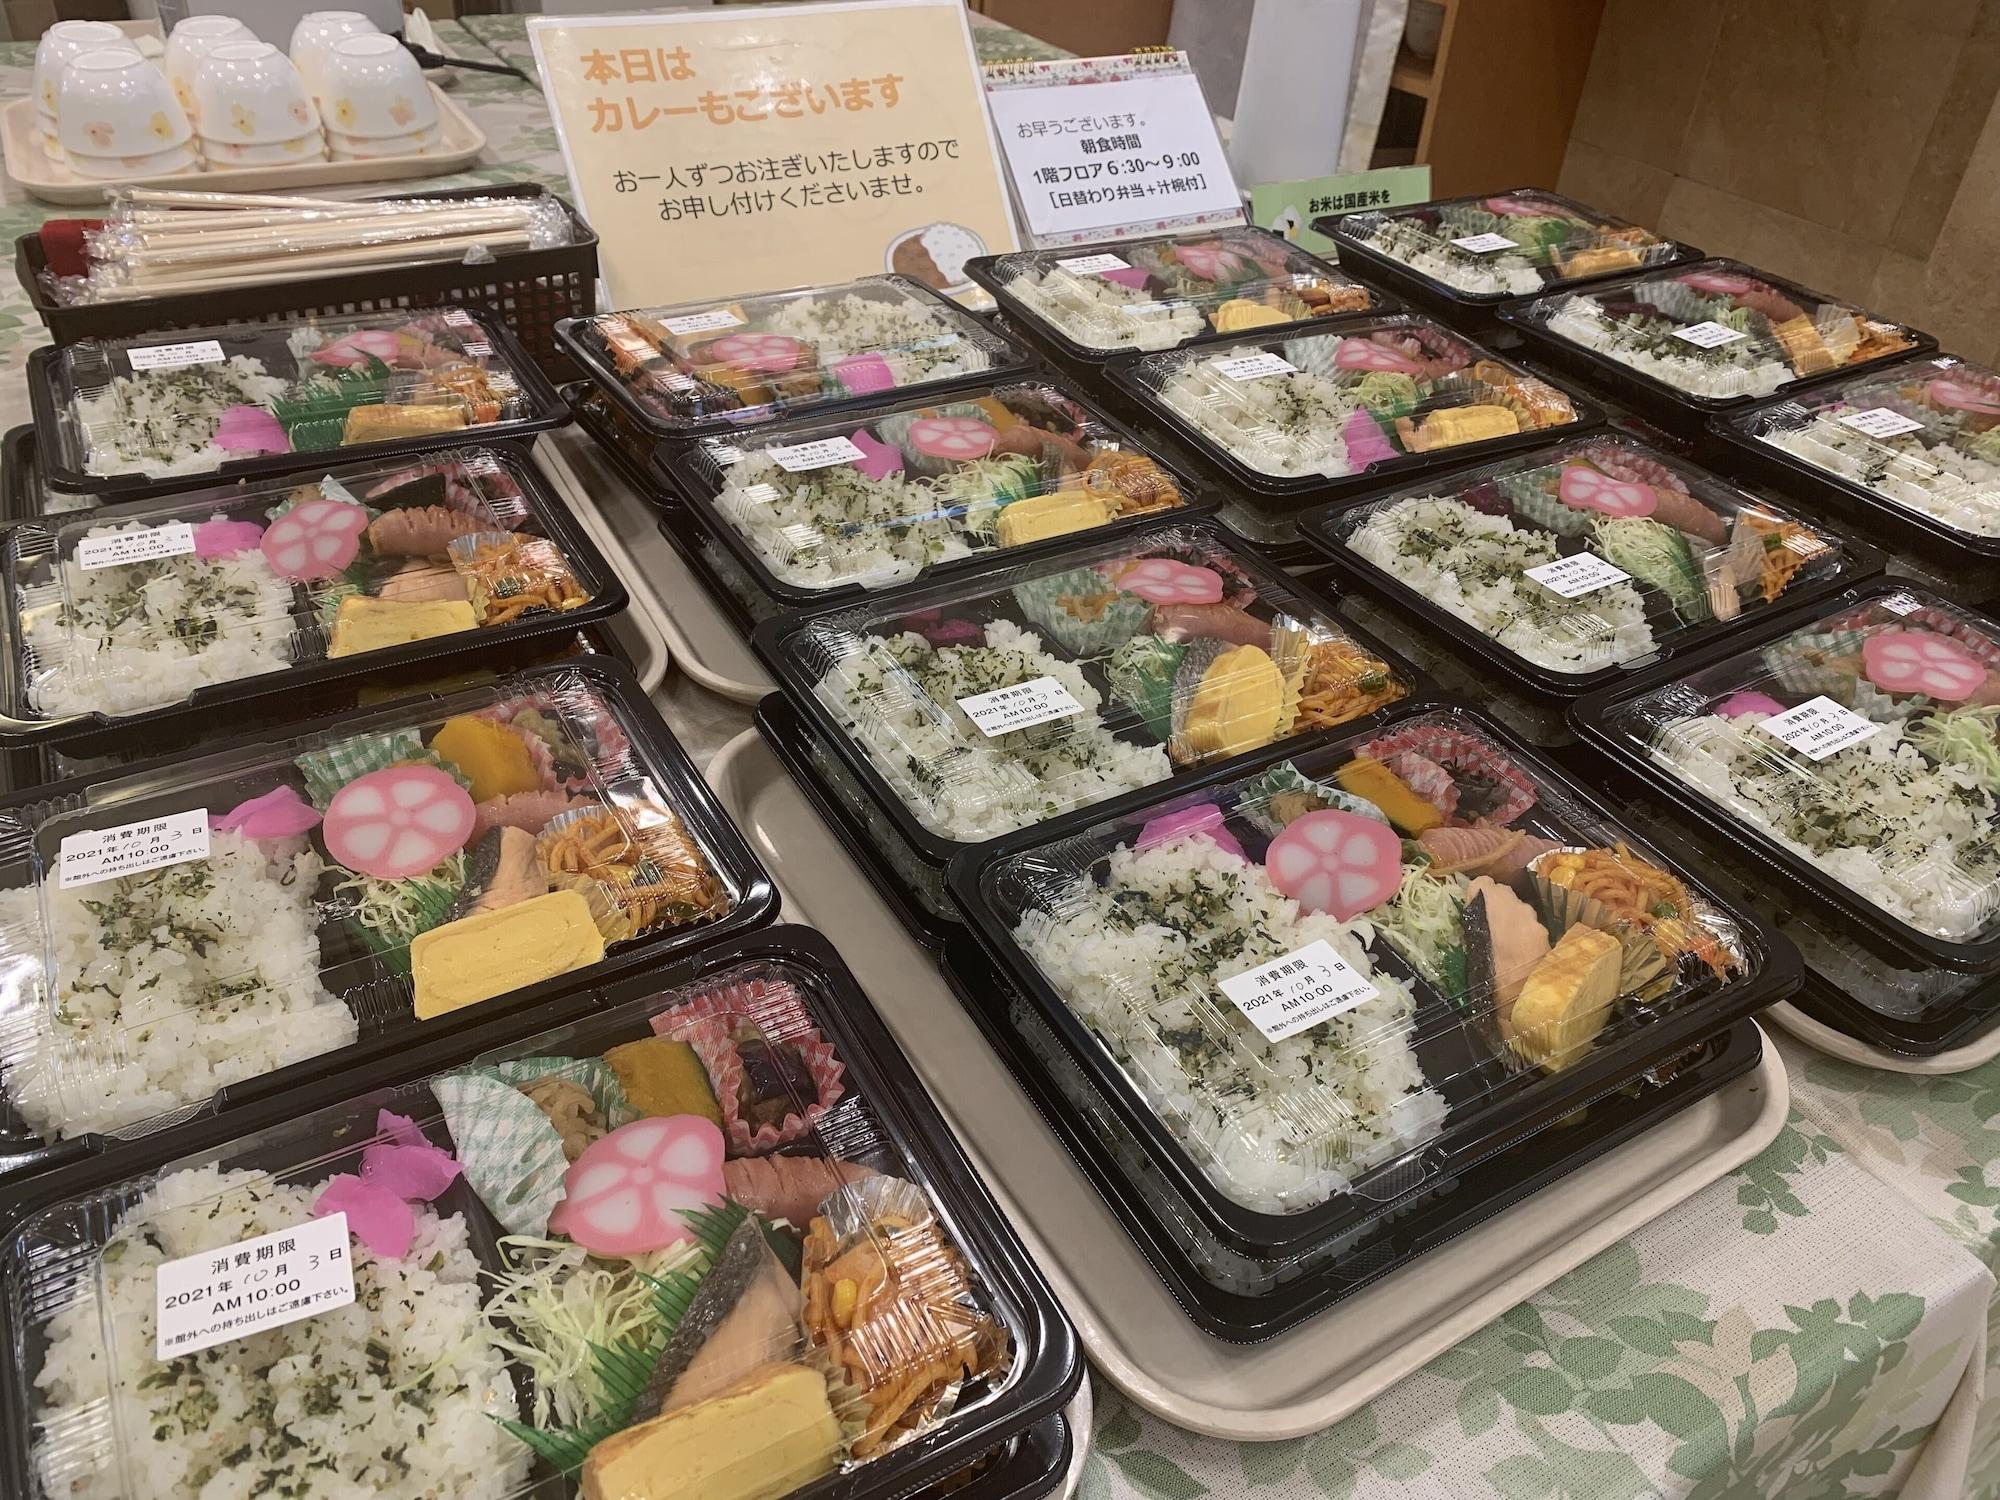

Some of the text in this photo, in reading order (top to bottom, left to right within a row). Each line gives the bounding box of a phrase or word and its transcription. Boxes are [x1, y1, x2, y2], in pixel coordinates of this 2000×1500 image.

[580, 46, 696, 85] 本日は
[587, 73, 904, 134] カレーもございます
[1016, 113, 1147, 138] お早うございます。
[1081, 134, 1142, 155] 朝食時間
[612, 139, 960, 194] お一人ずつお注ぎいたしますので
[659, 175, 926, 222] お申し付けくださいませ。
[1309, 189, 1390, 213] お米は国産米を
[988, 687, 1034, 704] 消費期限
[1003, 702, 1048, 719] AM10:00
[1783, 707, 1820, 726] 消費期限
[1810, 723, 1845, 742] AM10:00
[102, 823, 168, 843] 消費期限
[101, 844, 169, 864] AM10:00
[1254, 959, 1309, 987] 消費期限
[1281, 984, 1333, 1012] AM10:00
[211, 1238, 296, 1275] 消費期限
[212, 1279, 301, 1315] AM10:00
